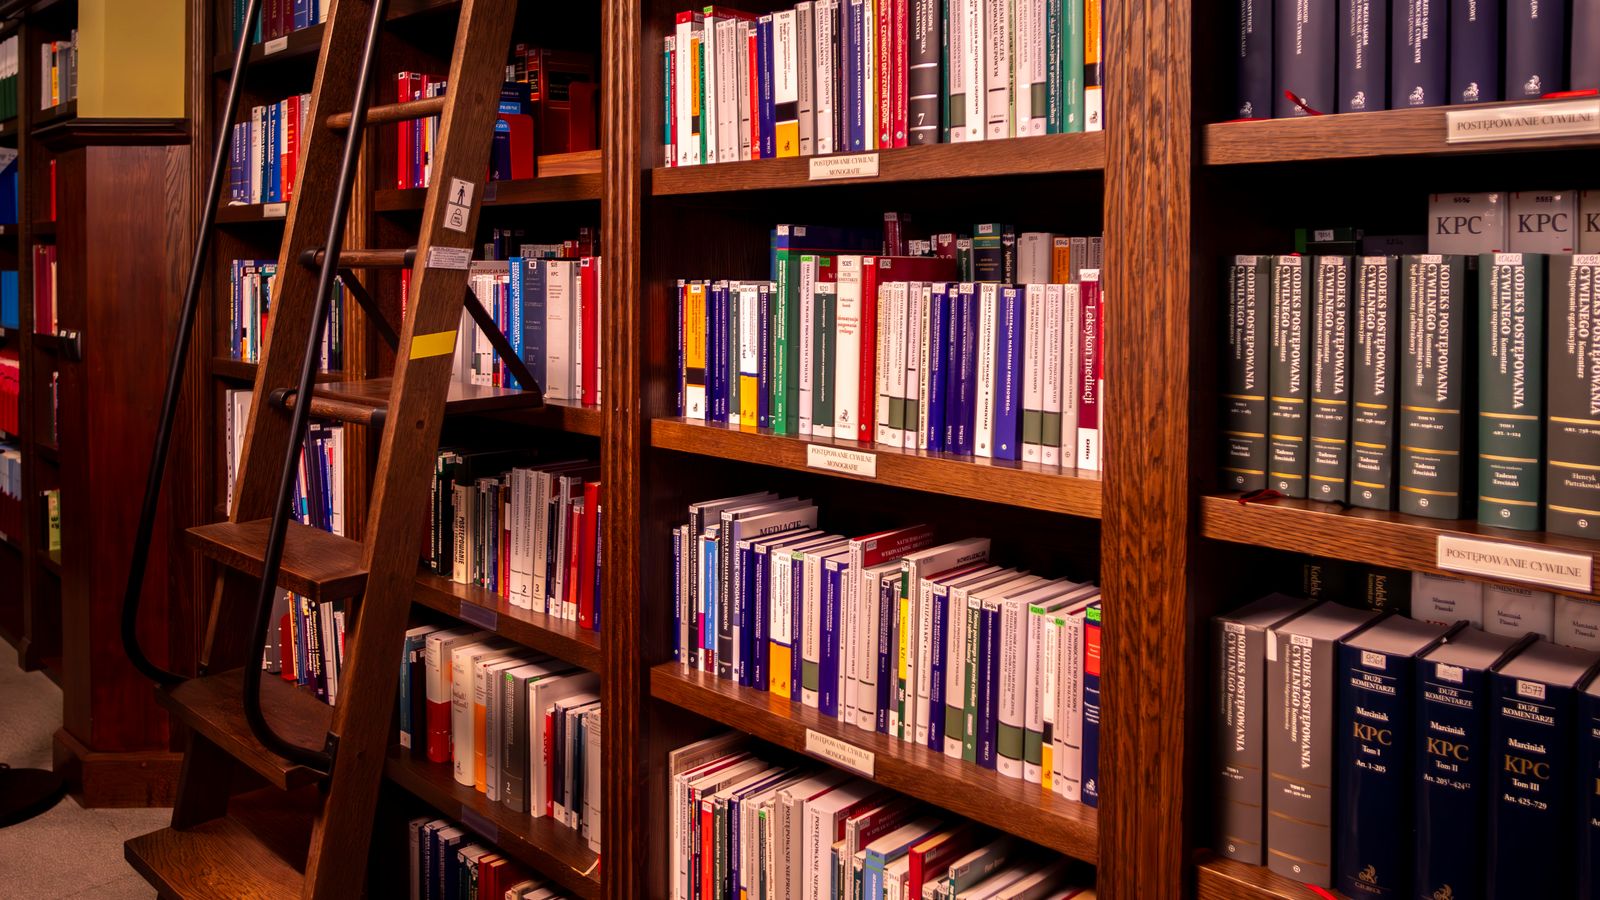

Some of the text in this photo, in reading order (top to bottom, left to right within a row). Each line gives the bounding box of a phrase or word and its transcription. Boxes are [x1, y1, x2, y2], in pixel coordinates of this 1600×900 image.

[917, 113, 925, 126] 7
[1456, 113, 1594, 132] POSTĘPOWANIE CYWILNE
[1436, 216, 1482, 235] KPC
[1518, 213, 1568, 233] KPC
[1236, 266, 1244, 325] CYWILNEGO
[1282, 266, 1290, 326] CYWILNEGO
[1325, 264, 1334, 327] CYWILNEGO
[1367, 265, 1376, 329] CYWILNEGO
[1427, 264, 1437, 330] CYWILNEGO
[1491, 266, 1499, 310] Postępowanie
[1500, 266, 1511, 374] CYWILNEGO Komentarz
[1568, 266, 1577, 354] Postępowanie egzekucyjne
[1578, 266, 1590, 378] CYWILNEGO Komentarz
[1244, 266, 1255, 389] KODEKS POSTĘPOWANIA
[1289, 266, 1301, 392] KODEKS POSTĘPOWANIA
[1333, 265, 1346, 394] KODEKS POSTĘPOWANIA
[1374, 265, 1387, 395] KODEKS POSTĘPOWANIA
[1435, 264, 1450, 401] KODEKS POSTĘPOWANIA
[1509, 266, 1525, 408] KODEKS POSTĘPOWANIA
[1083, 305, 1096, 404] Leksykon mediacji
[1573, 473, 1596, 481] Henryk
[759, 523, 802, 535] MEDIACJE
[1446, 547, 1581, 577] POSTĘPOWANIE CYWILNE
[521, 584, 528, 594] 2
[535, 584, 540, 593] 3
[1375, 575, 1387, 607] Kodeks
[1228, 632, 1236, 692] CYWILNEGO
[1292, 645, 1300, 706] CYWILNEGO
[1234, 634, 1246, 751] KODEKS POSTĘPOWANIA
[1351, 678, 1396, 693] KOMENTARZE
[1425, 691, 1473, 707] KOMENTARZE
[1300, 648, 1311, 768] KODEKS POSTĘPOWANIA
[1356, 706, 1389, 721] Marciniak
[1502, 707, 1555, 724] KOMENTARZE
[1353, 722, 1392, 746] KPC
[1430, 721, 1466, 736] Marciniak
[1361, 744, 1376, 755] Tom
[1426, 737, 1469, 761] KPC
[1508, 738, 1546, 754] Marciniak
[1436, 760, 1451, 771] Tom
[1504, 754, 1550, 780] KPC
[1504, 794, 1517, 803] Art.
[1512, 778, 1539, 791] Tom III
[783, 806, 791, 863] POSTĘPOWANIE
[812, 816, 820, 871] POSTĘPOWANIE
